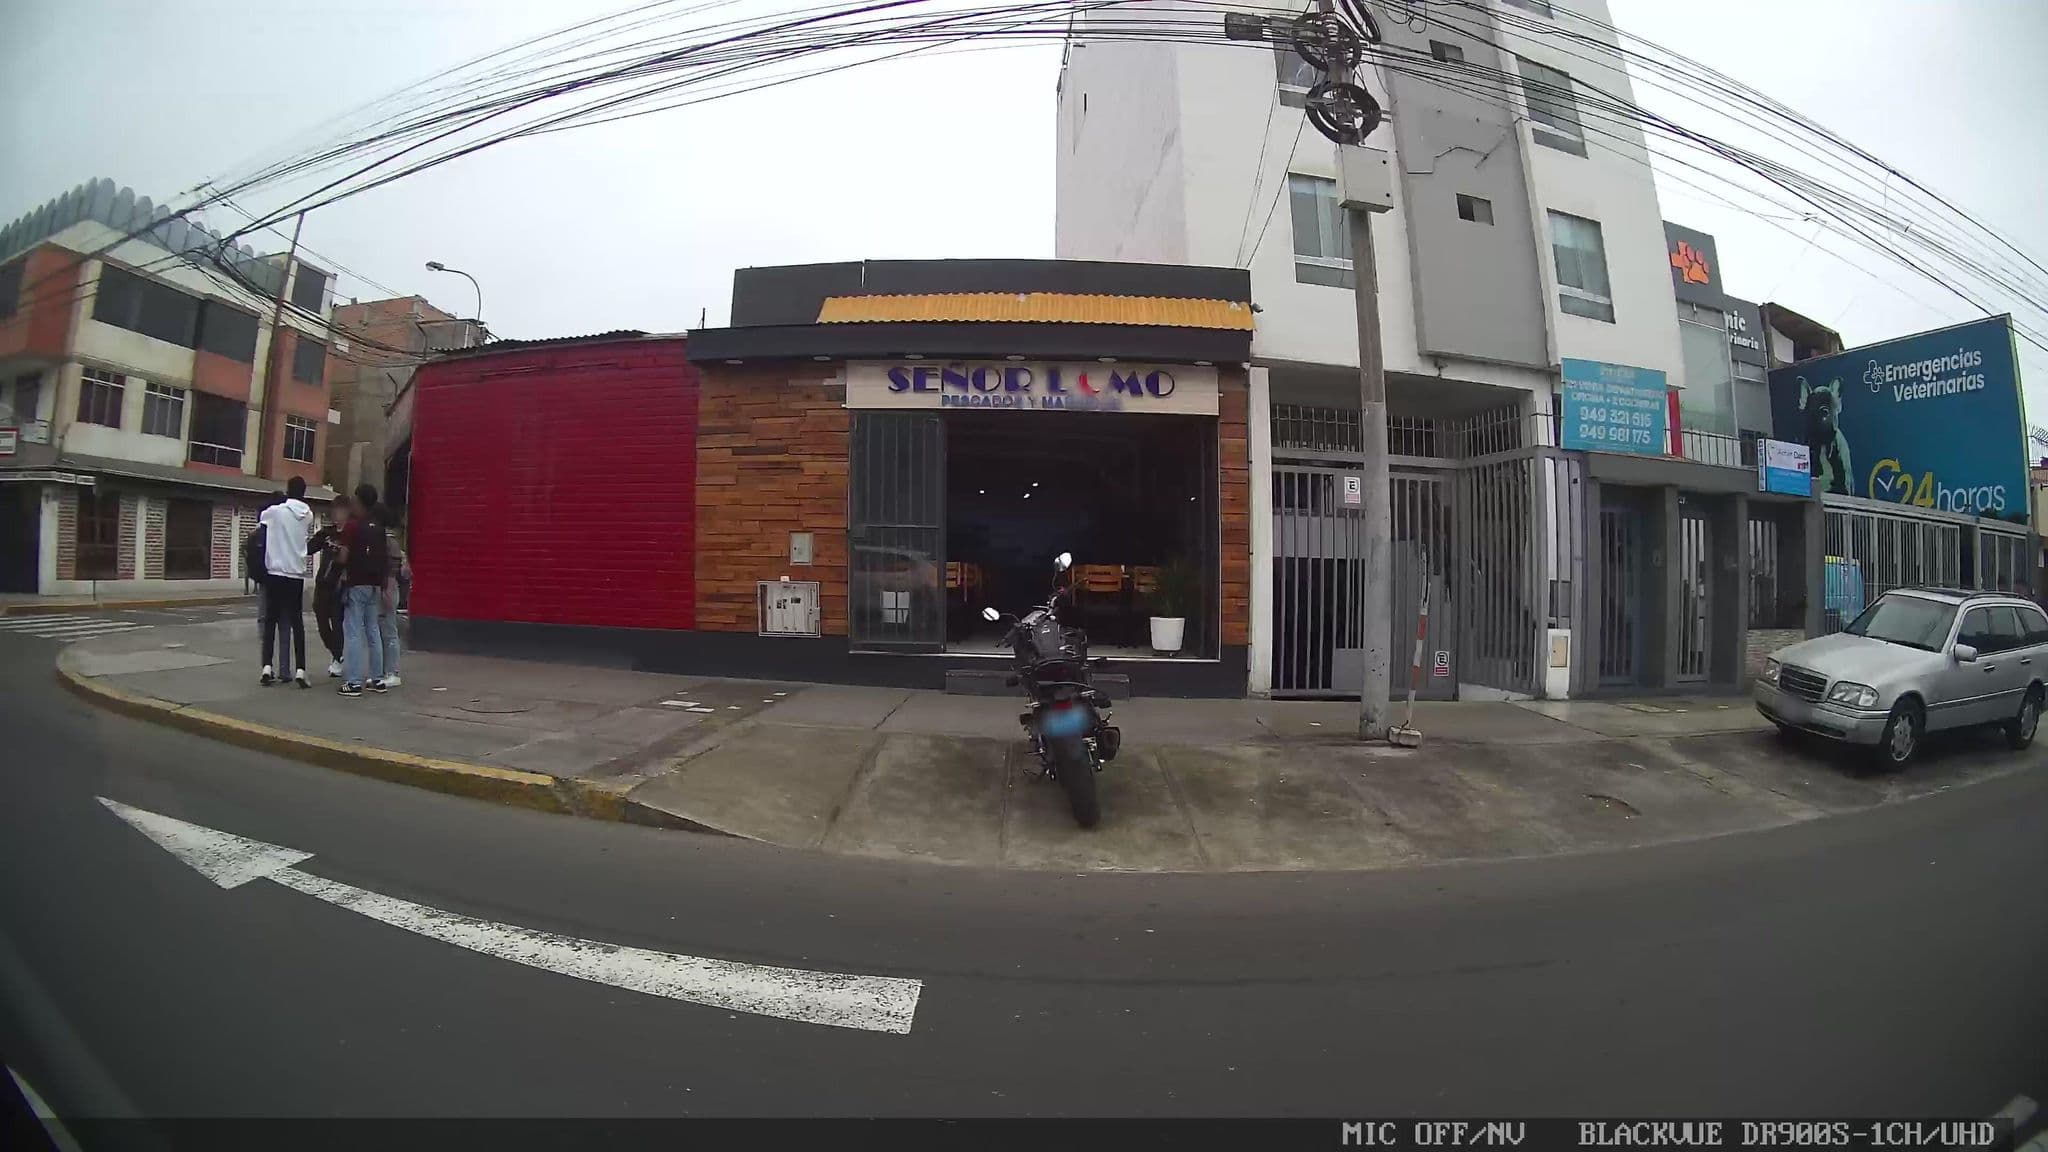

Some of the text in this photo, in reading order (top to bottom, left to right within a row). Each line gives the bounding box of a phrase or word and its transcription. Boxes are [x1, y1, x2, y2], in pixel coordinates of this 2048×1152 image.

[1885, 348, 1982, 383] Emergencias
[1893, 371, 1985, 402] Veterinarias
[1580, 406, 1607, 422] 949
[1609, 408, 1629, 425] 321
[1579, 424, 1606, 440] 949
[1609, 427, 1629, 442] 981
[1632, 429, 1652, 445] 175
[1895, 471, 2007, 513] 24 horas
